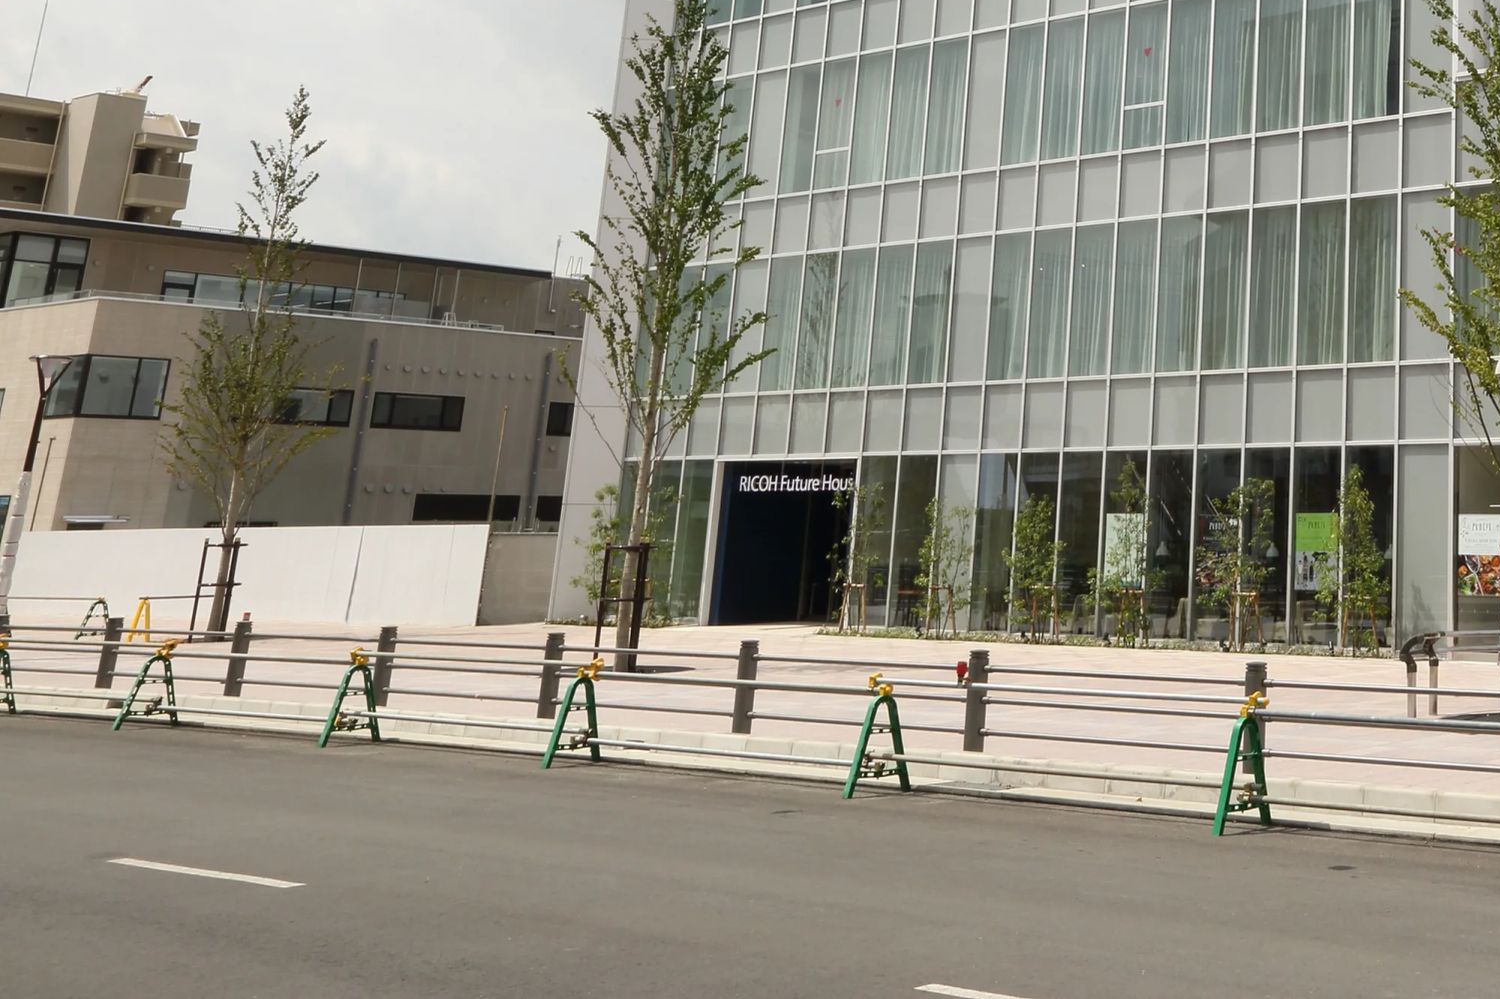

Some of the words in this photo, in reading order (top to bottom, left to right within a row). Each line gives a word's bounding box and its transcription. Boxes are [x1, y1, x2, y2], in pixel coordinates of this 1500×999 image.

[739, 474, 779, 492] RICOH
[780, 474, 820, 492] Future
[821, 473, 855, 492] Hous
